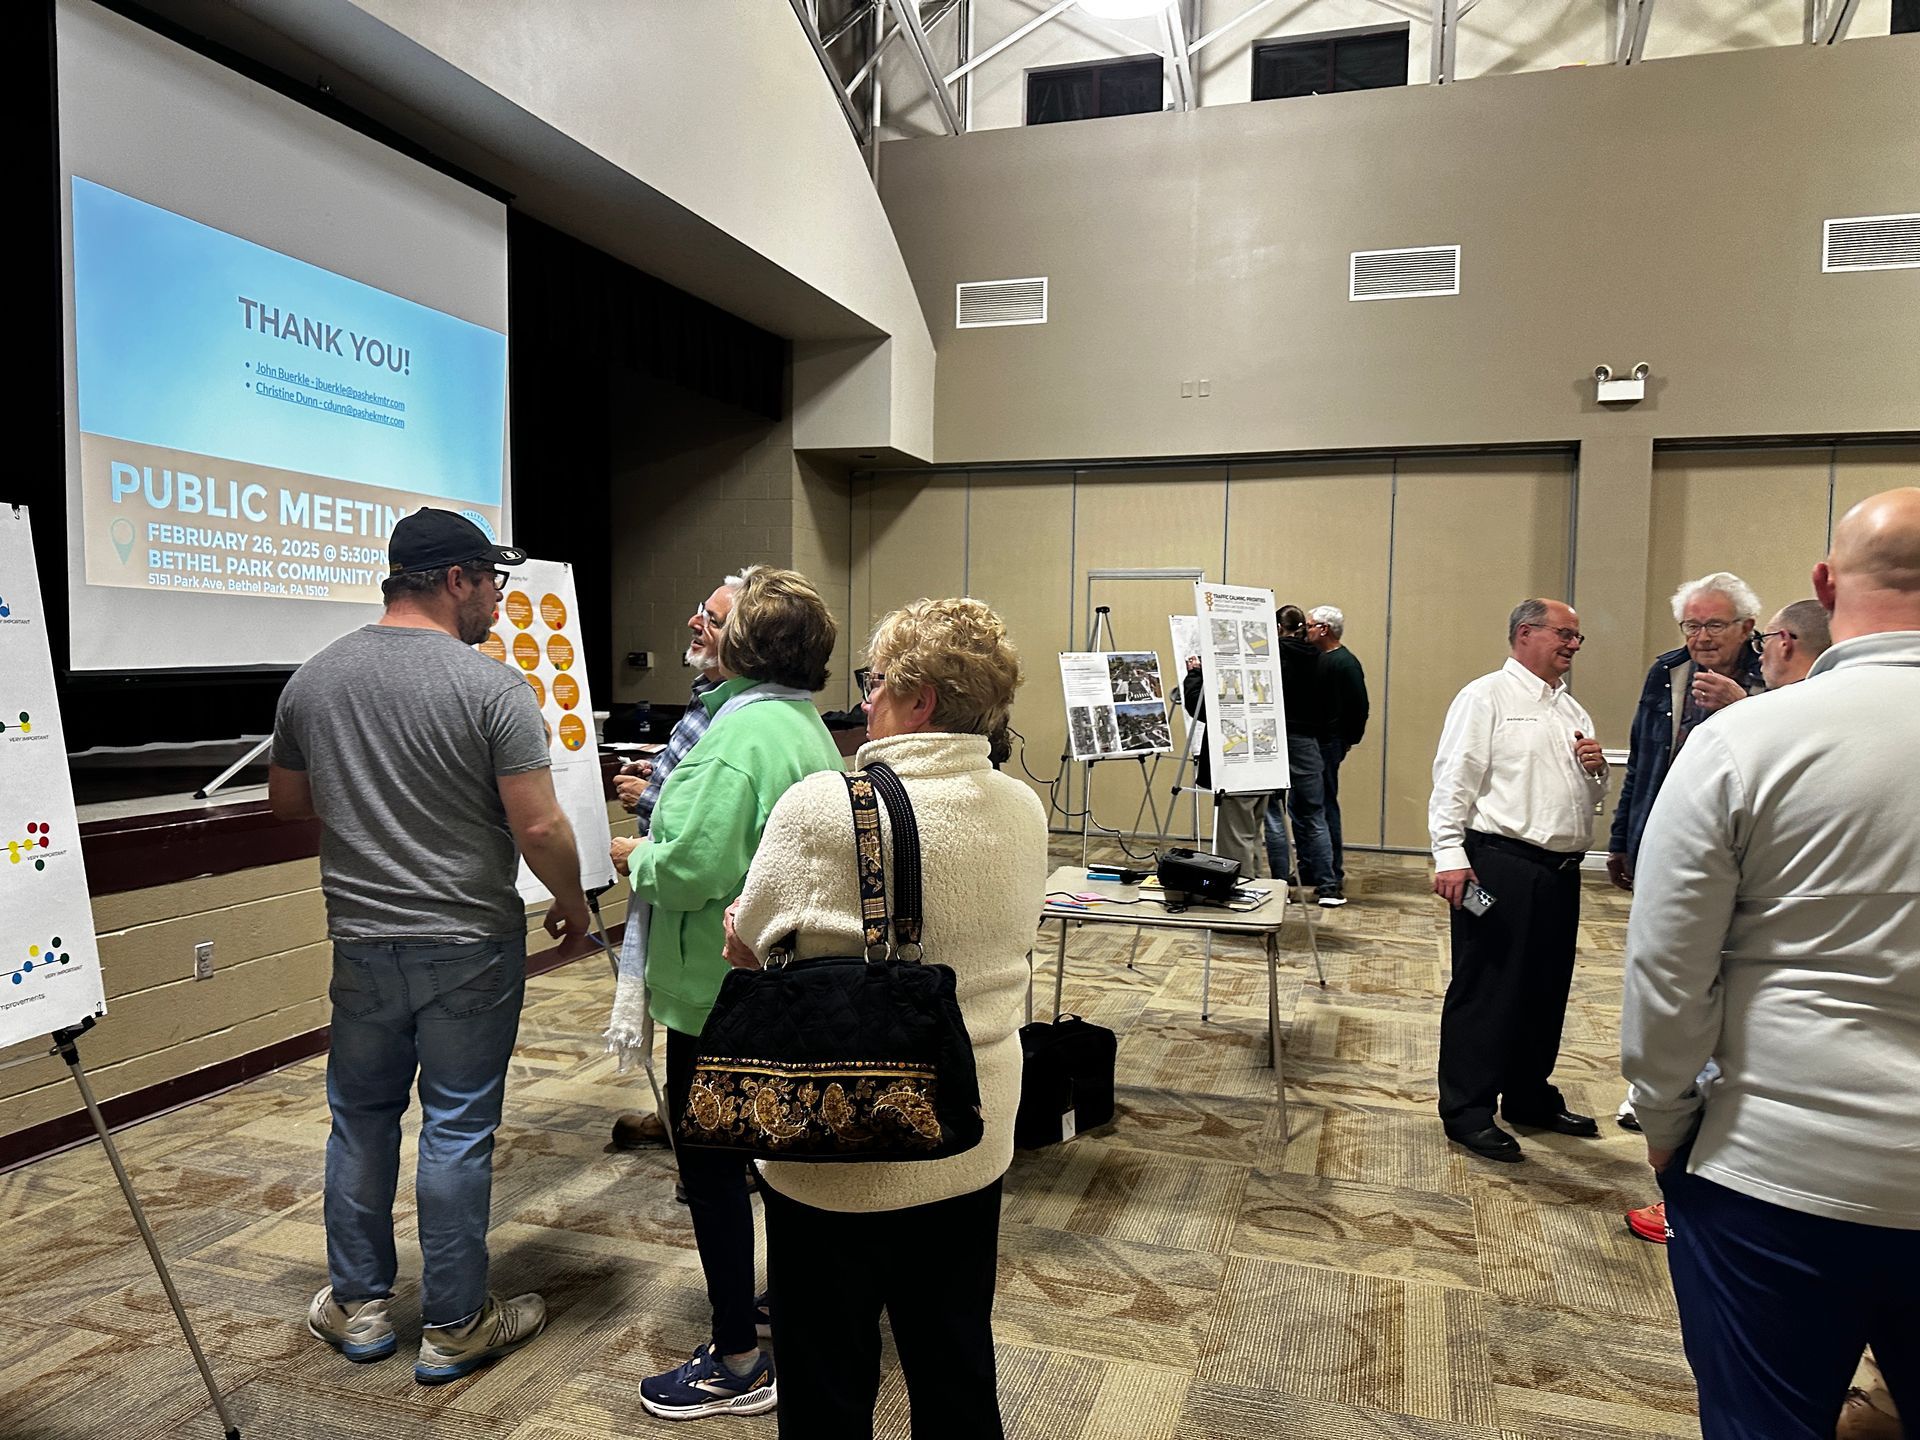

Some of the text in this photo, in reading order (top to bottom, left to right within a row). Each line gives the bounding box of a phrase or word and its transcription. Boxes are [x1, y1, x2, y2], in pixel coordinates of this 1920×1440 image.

[238, 296, 410, 376] THANK YOU!
[256, 362, 277, 378] John
[278, 367, 310, 387] Buerkle
[315, 377, 406, 411] jbuerkle@pashekmtr.com
[256, 382, 295, 402] Christine
[296, 391, 318, 408] Dunn
[323, 400, 405, 429] cdunn@pashekmtr.com
[111, 460, 406, 539] PUBLIC MEETIN
[148, 522, 247, 551] FEBRUARY
[252, 535, 278, 557] 26,
[281, 539, 320, 559] 2025
[323, 546, 337, 562] @
[148, 549, 223, 574] BETHEL
[227, 558, 273, 578] PARK
[277, 562, 374, 586] COMMUNITY
[148, 573, 330, 597] 5151 Park Ave, Bethel Park, PA 15102
[0, 993, 46, 1010] mprovements
